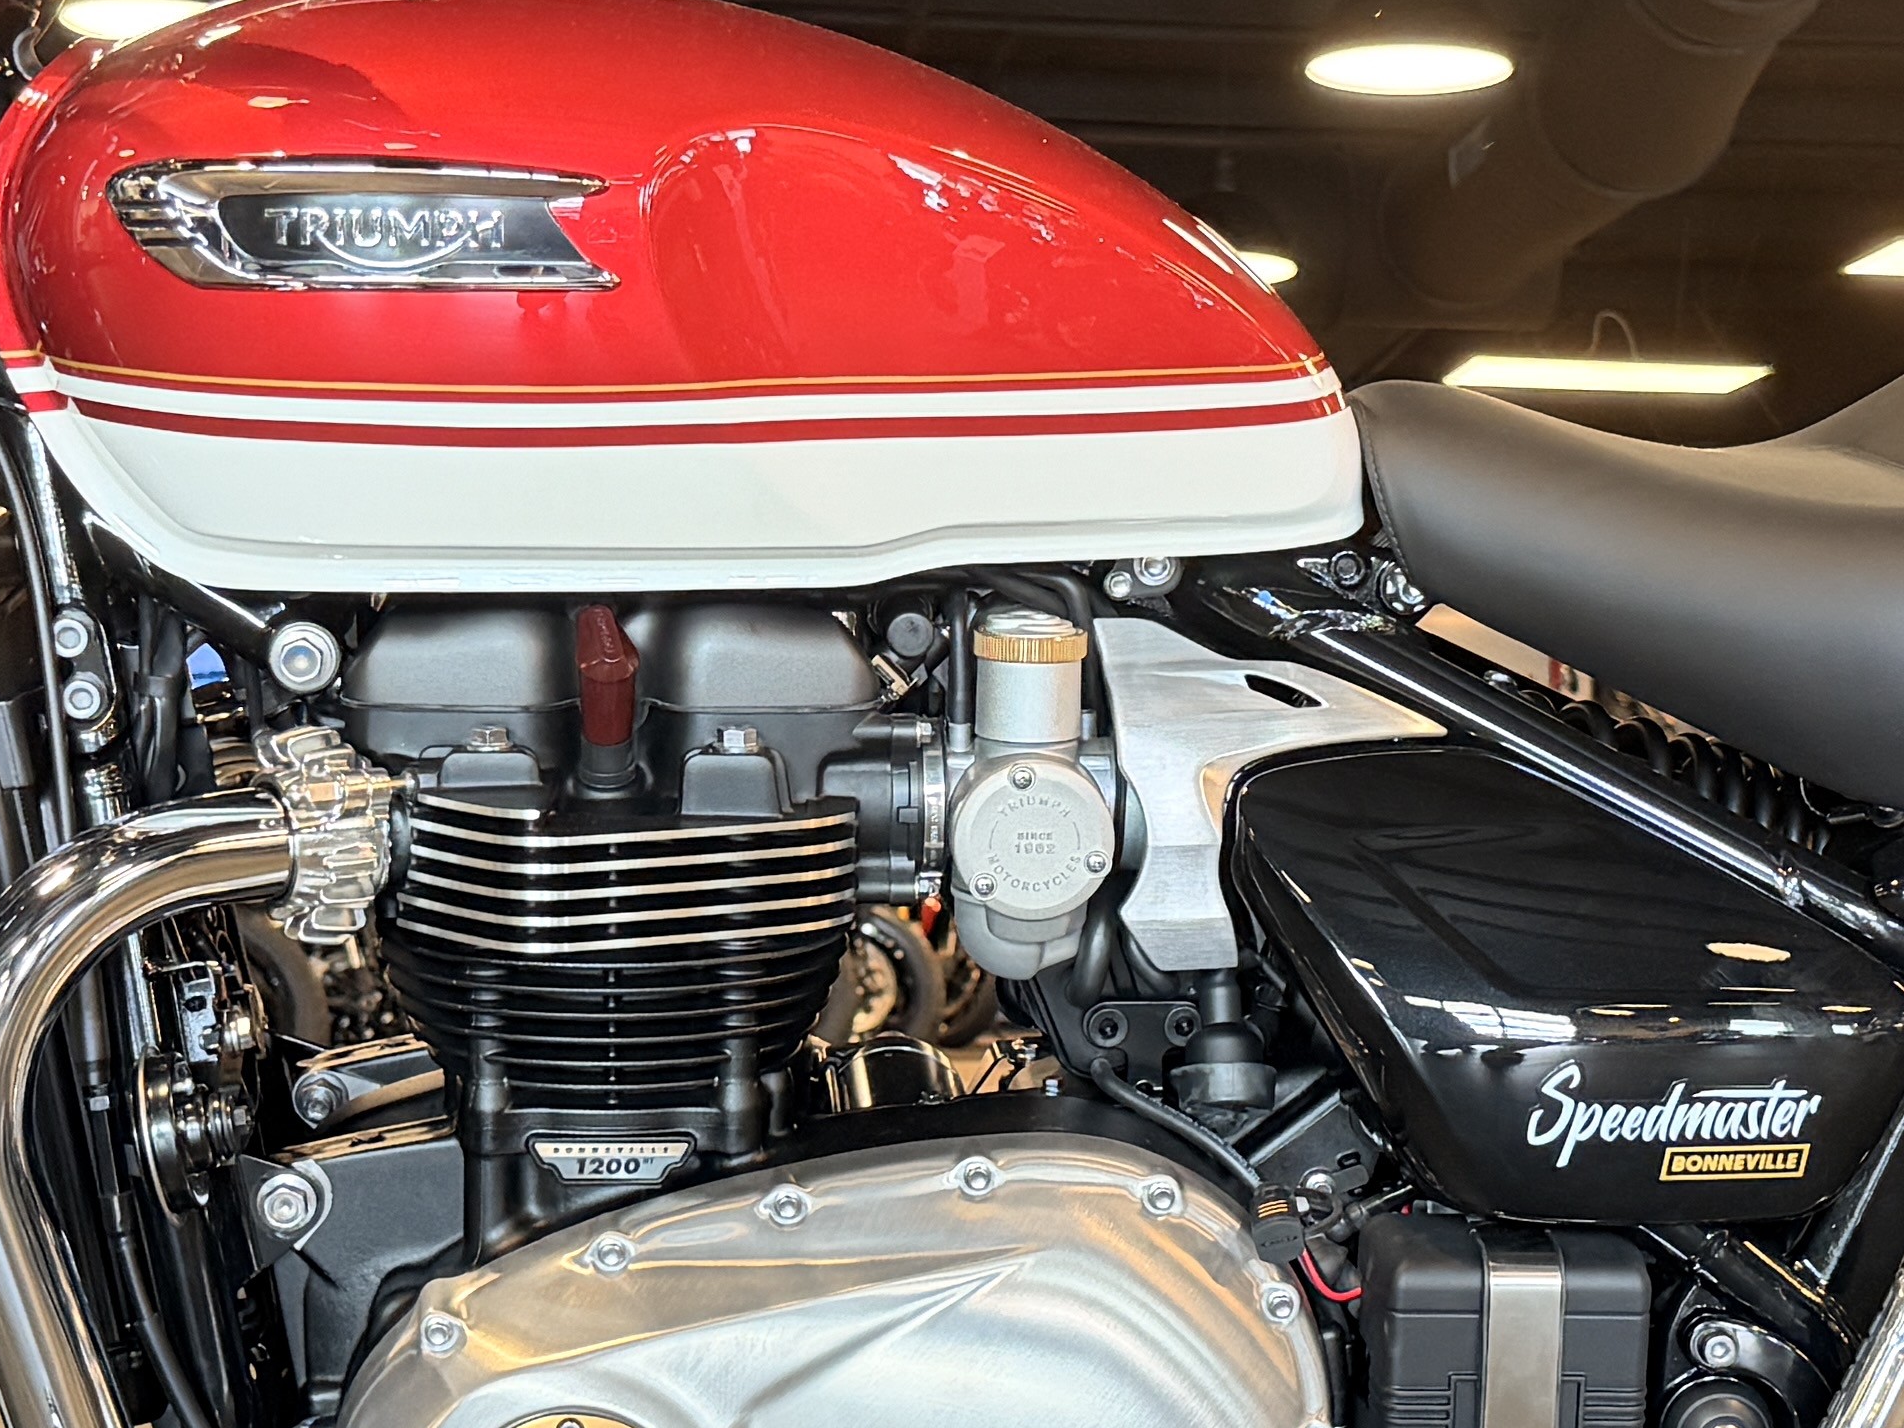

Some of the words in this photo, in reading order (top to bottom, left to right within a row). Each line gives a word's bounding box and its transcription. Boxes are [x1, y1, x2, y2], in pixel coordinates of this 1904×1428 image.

[263, 205, 506, 269] TRIUMPH
[997, 795, 1071, 818] TRIUMPH
[1017, 832, 1053, 841] SINCE
[987, 854, 1081, 892] MOTORCYCLES
[1526, 1061, 1823, 1168] Speedmaster
[576, 1158, 641, 1175] 1200
[1671, 1152, 1800, 1173] BONNEVILLE
